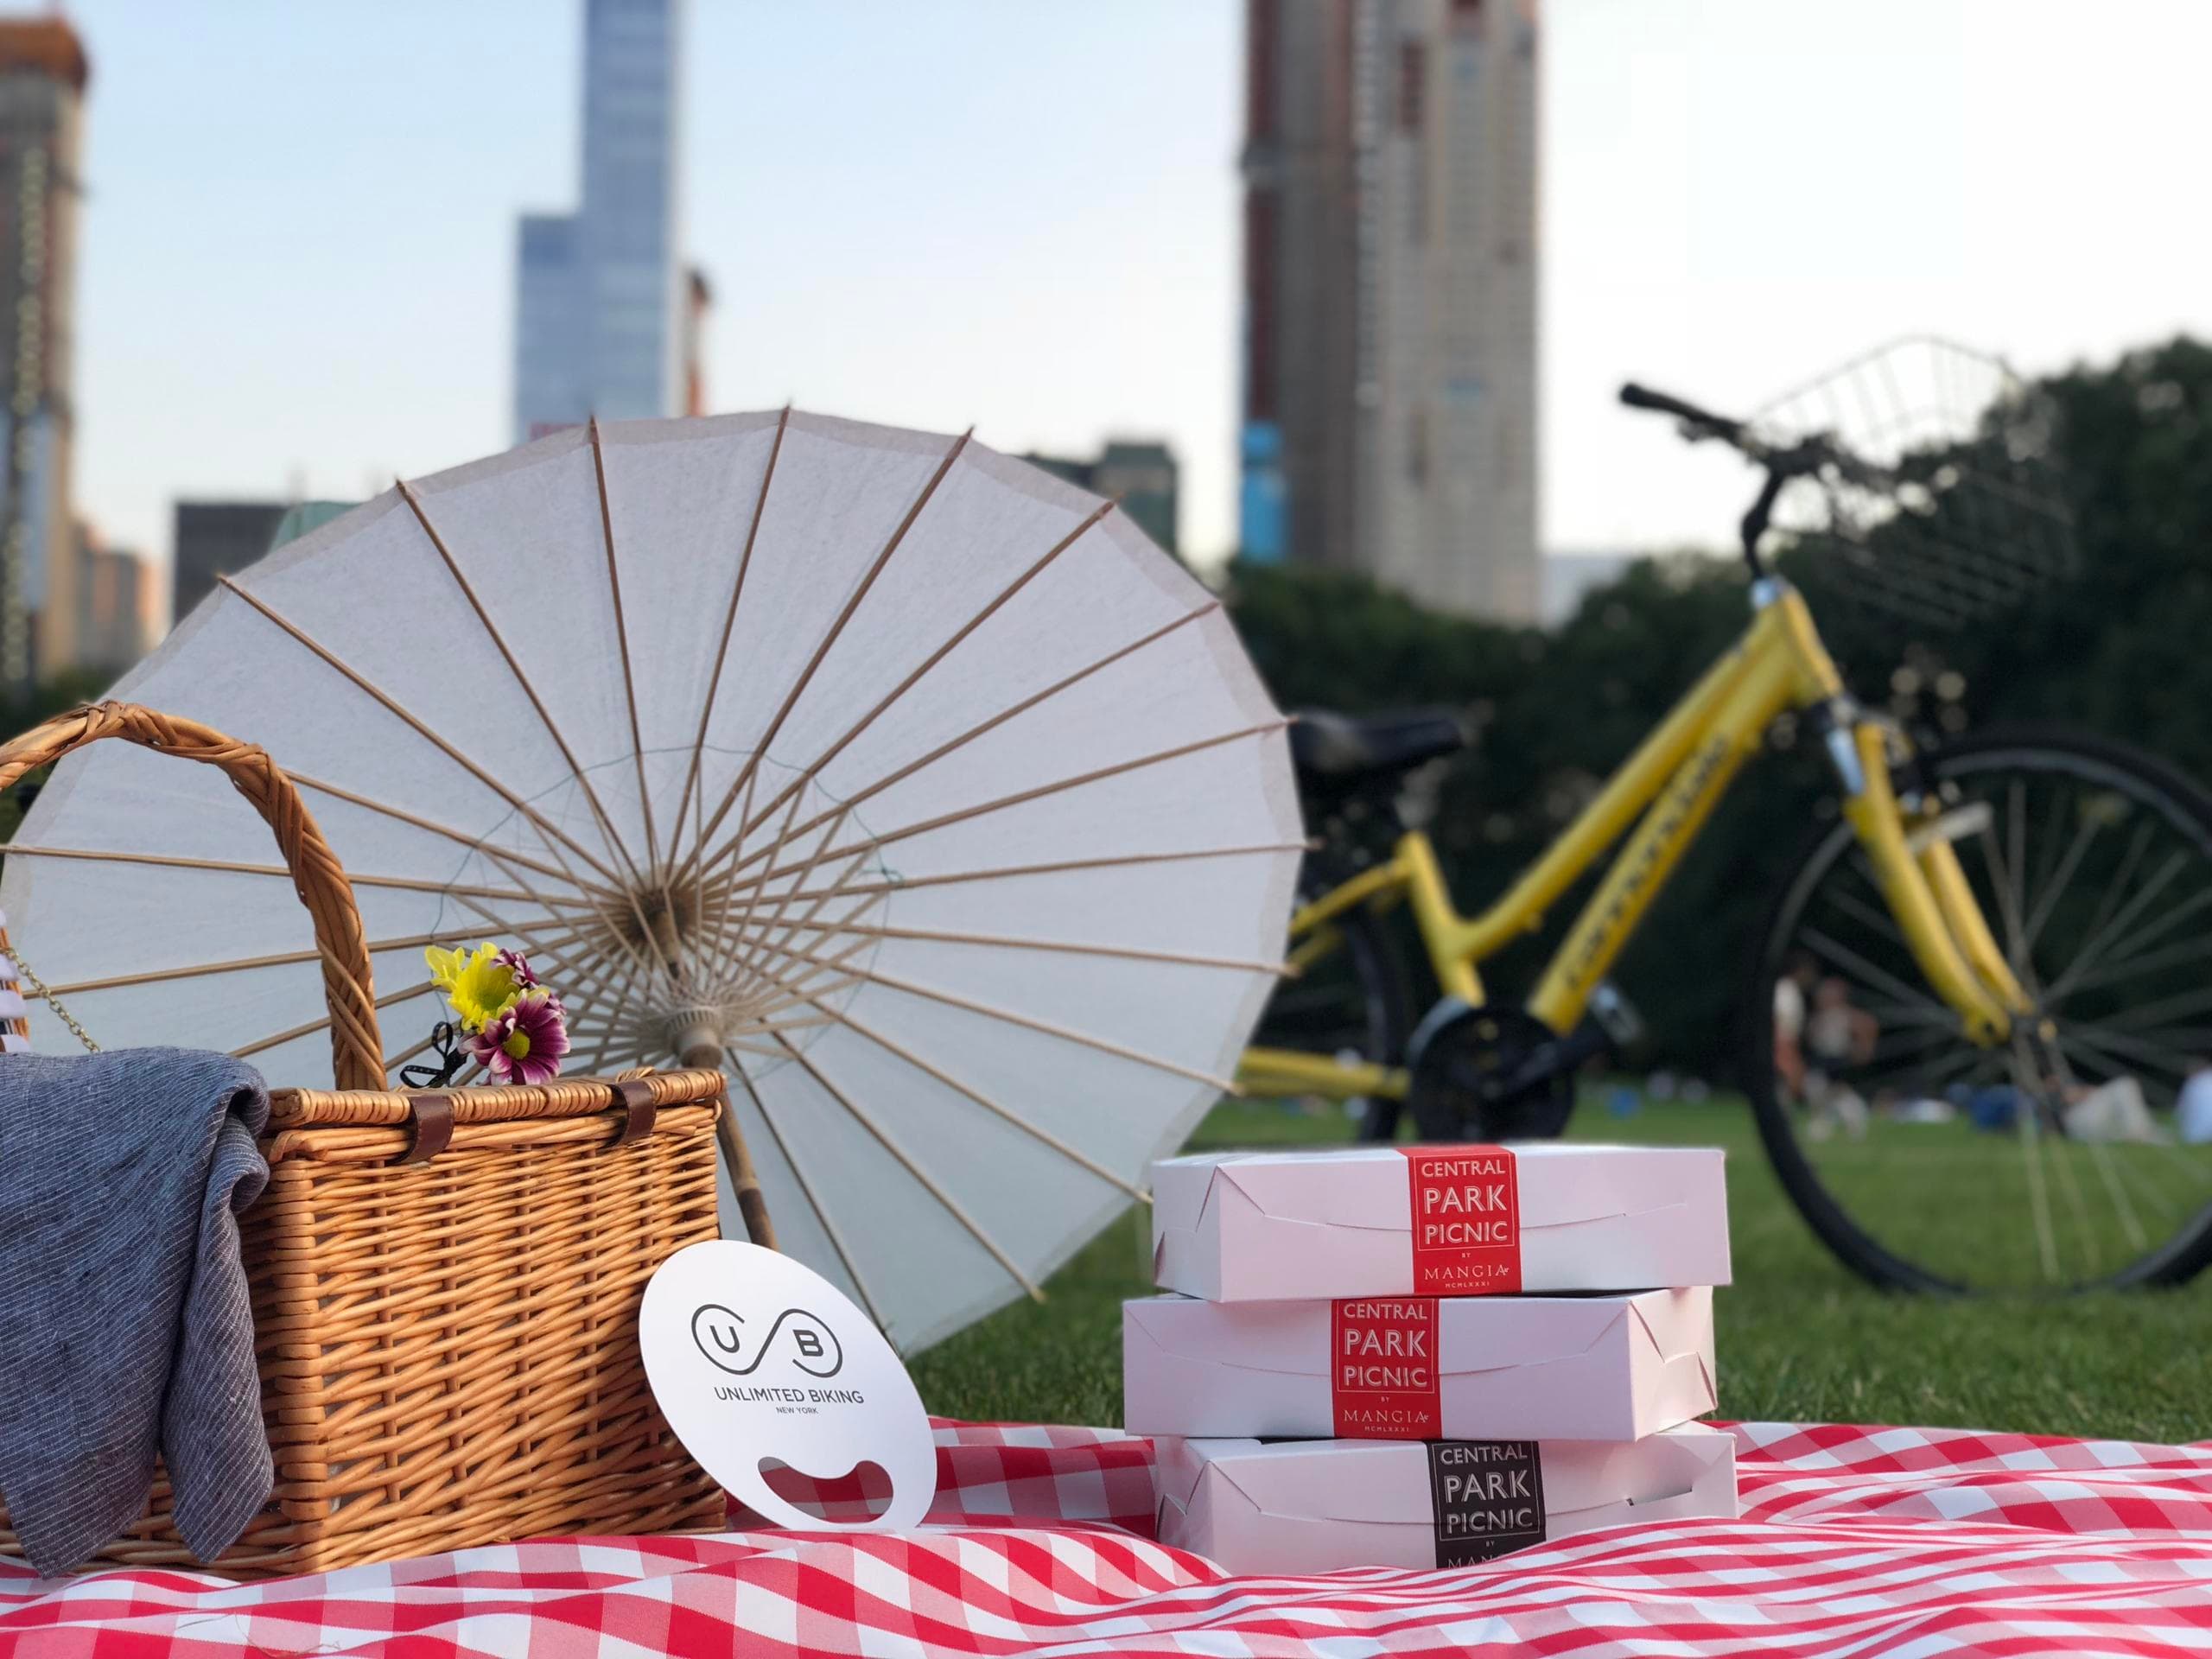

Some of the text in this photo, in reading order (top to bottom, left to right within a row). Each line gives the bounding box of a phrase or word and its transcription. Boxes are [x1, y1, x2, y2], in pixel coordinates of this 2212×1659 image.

[1421, 1159, 1506, 1178] CENTRAL
[1423, 1185, 1508, 1214] PARK
[1424, 1221, 1508, 1244] PICNIC
[1424, 1264, 1508, 1280] MANGIA
[1344, 1303, 1428, 1320] CENTRAL
[1344, 1328, 1427, 1357] PARK
[1344, 1365, 1427, 1388] PICNIC
[714, 1387, 865, 1404] UNLIMITED BIKING
[1344, 1410, 1427, 1423] MANGIA
[1440, 1444, 1528, 1465] CENTRAL
[1444, 1470, 1531, 1503] PARK
[1446, 1507, 1533, 1535] PICNIC
